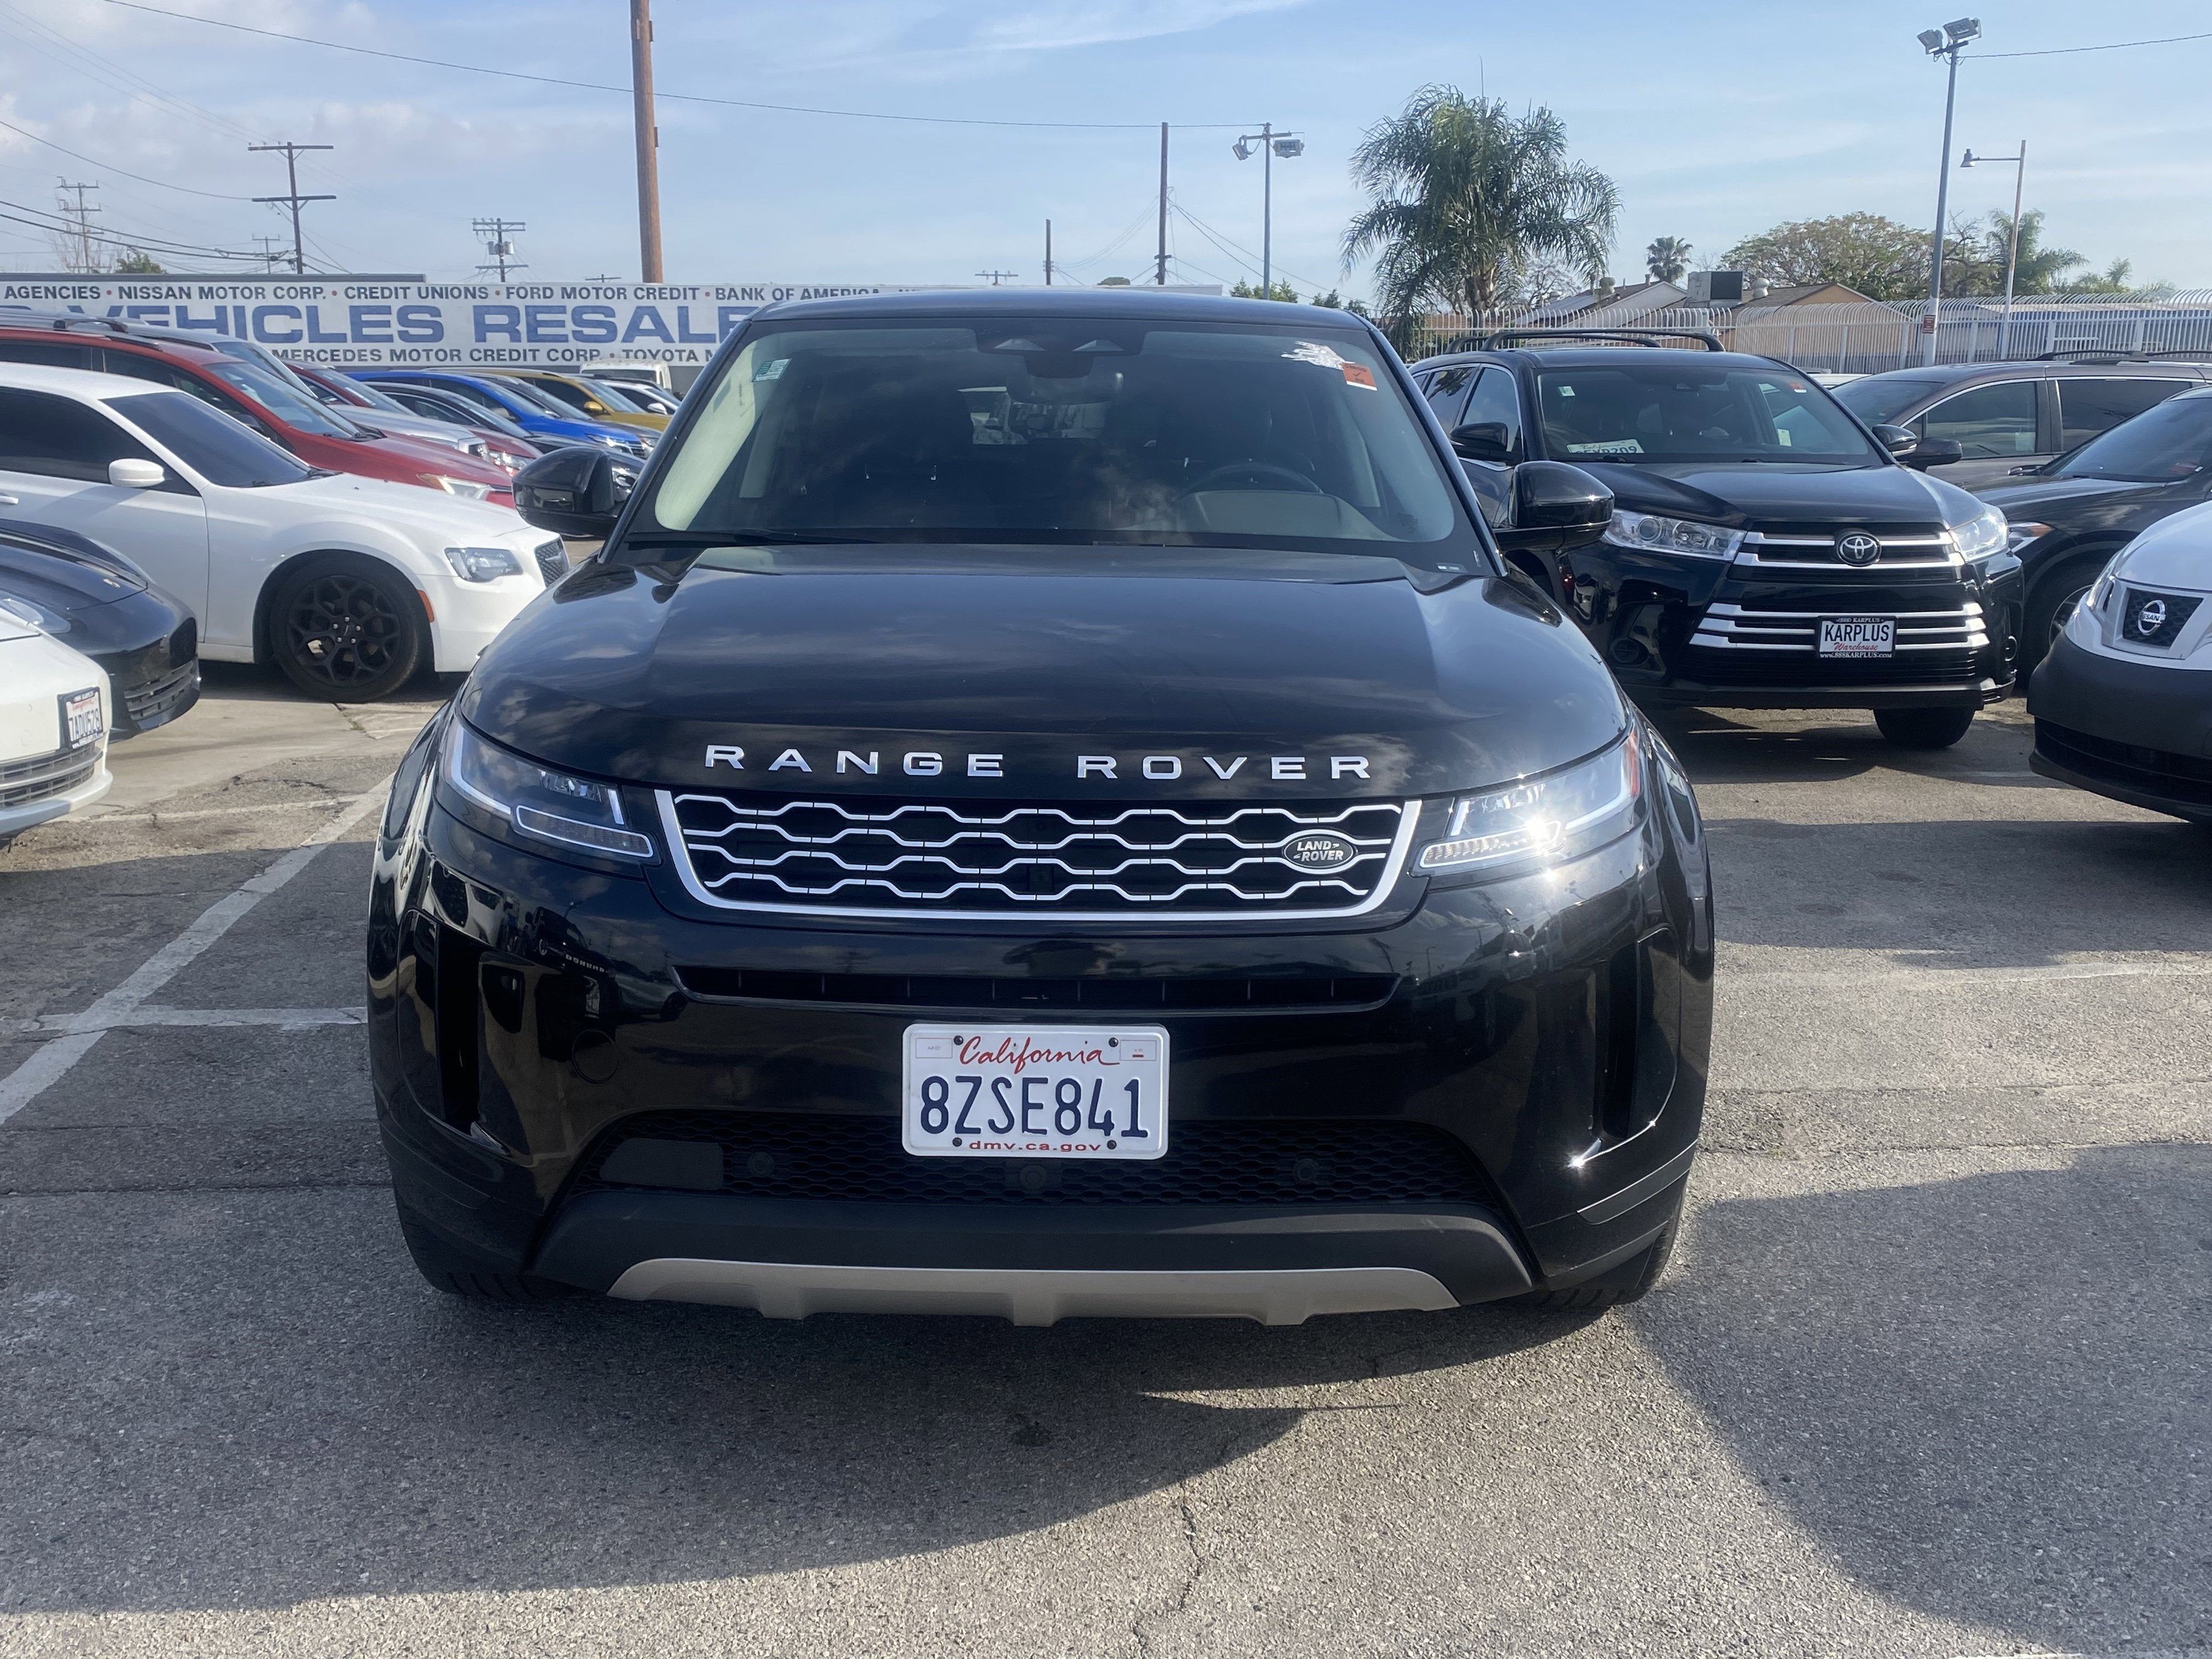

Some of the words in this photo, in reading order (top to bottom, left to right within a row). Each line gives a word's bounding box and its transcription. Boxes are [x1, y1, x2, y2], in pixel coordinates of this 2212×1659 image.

[4, 286, 101, 299] AGENCIES
[118, 286, 191, 300] NISSAN
[198, 286, 266, 300] MOTOR
[273, 286, 326, 300] CORP.
[344, 286, 410, 300] CREDIT
[417, 286, 489, 300] UNIONS
[506, 286, 554, 300] FORD
[561, 286, 628, 300] MOTOR
[634, 287, 700, 301] CREDIT
[715, 287, 765, 301] BANK
[772, 288, 794, 301] OF
[271, 349, 382, 362] MERCEDES
[390, 349, 462, 362] MOTOR
[469, 348, 540, 362] CREDIT
[622, 349, 699, 362] TOYOTA
[1825, 624, 1890, 642] KARPLUS
[1833, 641, 1879, 651] Warehouse
[704, 744, 1004, 777] RANGE
[1076, 755, 1371, 780] ROVER
[1296, 840, 1331, 851] LAND
[1301, 850, 1344, 862] ROVER
[959, 1036, 1120, 1074] California
[920, 1075, 1149, 1138] 8ZSE841
[968, 1140, 1102, 1152] dmv.ca.gov
